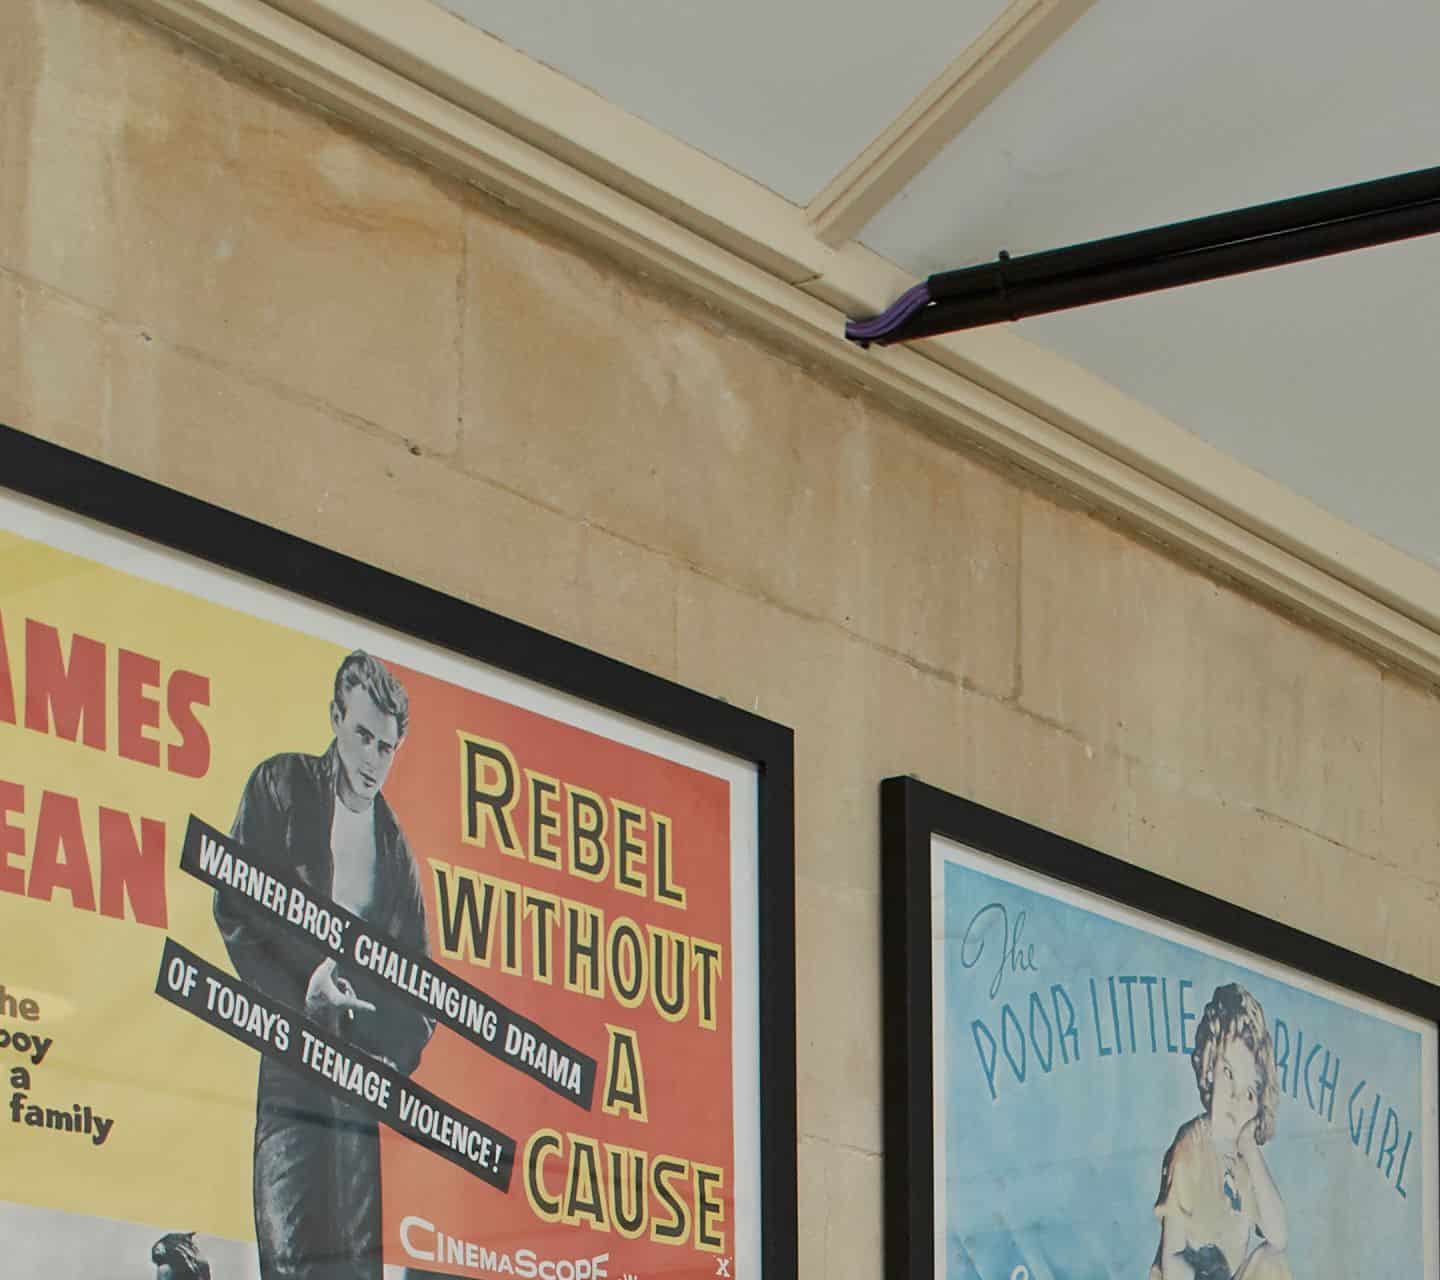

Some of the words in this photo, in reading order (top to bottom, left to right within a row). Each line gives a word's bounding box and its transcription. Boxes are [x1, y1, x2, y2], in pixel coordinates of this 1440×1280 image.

[456, 729, 688, 910] REBEL
[354, 933, 498, 1043] CHALLENGING
[504, 1026, 582, 1096] DRAMA
[427, 857, 723, 1031] WITHOUT
[960, 902, 1038, 1000] The
[9, 1091, 115, 1146] family
[10, 1066, 31, 1090] a
[167, 956, 198, 1000] OF
[205, 976, 291, 1052] TODAY'S
[301, 1030, 391, 1110] TEENAGE
[398, 1088, 504, 1174] VIOLENCE!
[601, 1022, 649, 1124] A
[970, 983, 1081, 1100] POOR
[1089, 975, 1197, 1057] LITTLE
[1274, 1017, 1341, 1122] RICH
[1347, 1079, 1414, 1199] GIRL
[523, 1127, 726, 1255] CAUSE
